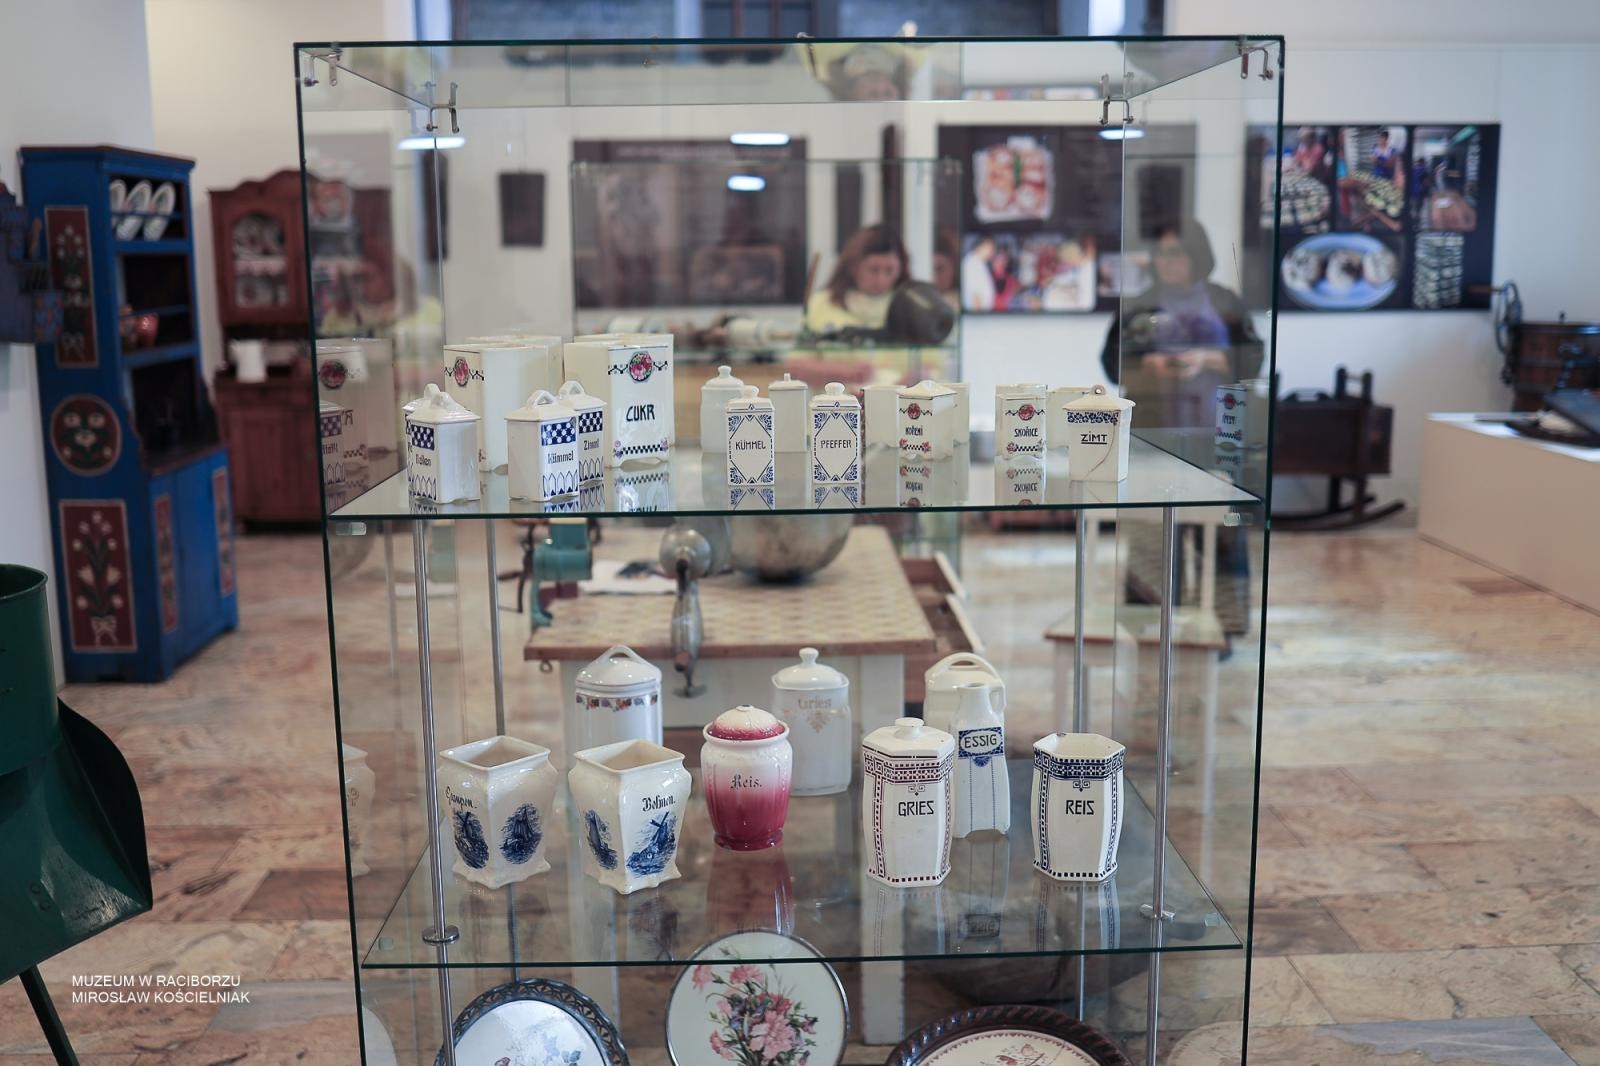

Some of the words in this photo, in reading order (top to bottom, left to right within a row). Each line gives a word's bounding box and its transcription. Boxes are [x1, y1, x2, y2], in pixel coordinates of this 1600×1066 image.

[626, 404, 656, 422] CUKR
[735, 438, 767, 450] KÜMMEL
[820, 439, 852, 449] PFEFFER
[964, 733, 998, 749] ESSIG
[898, 800, 935, 817] GRIES
[1065, 799, 1095, 816] REIS
